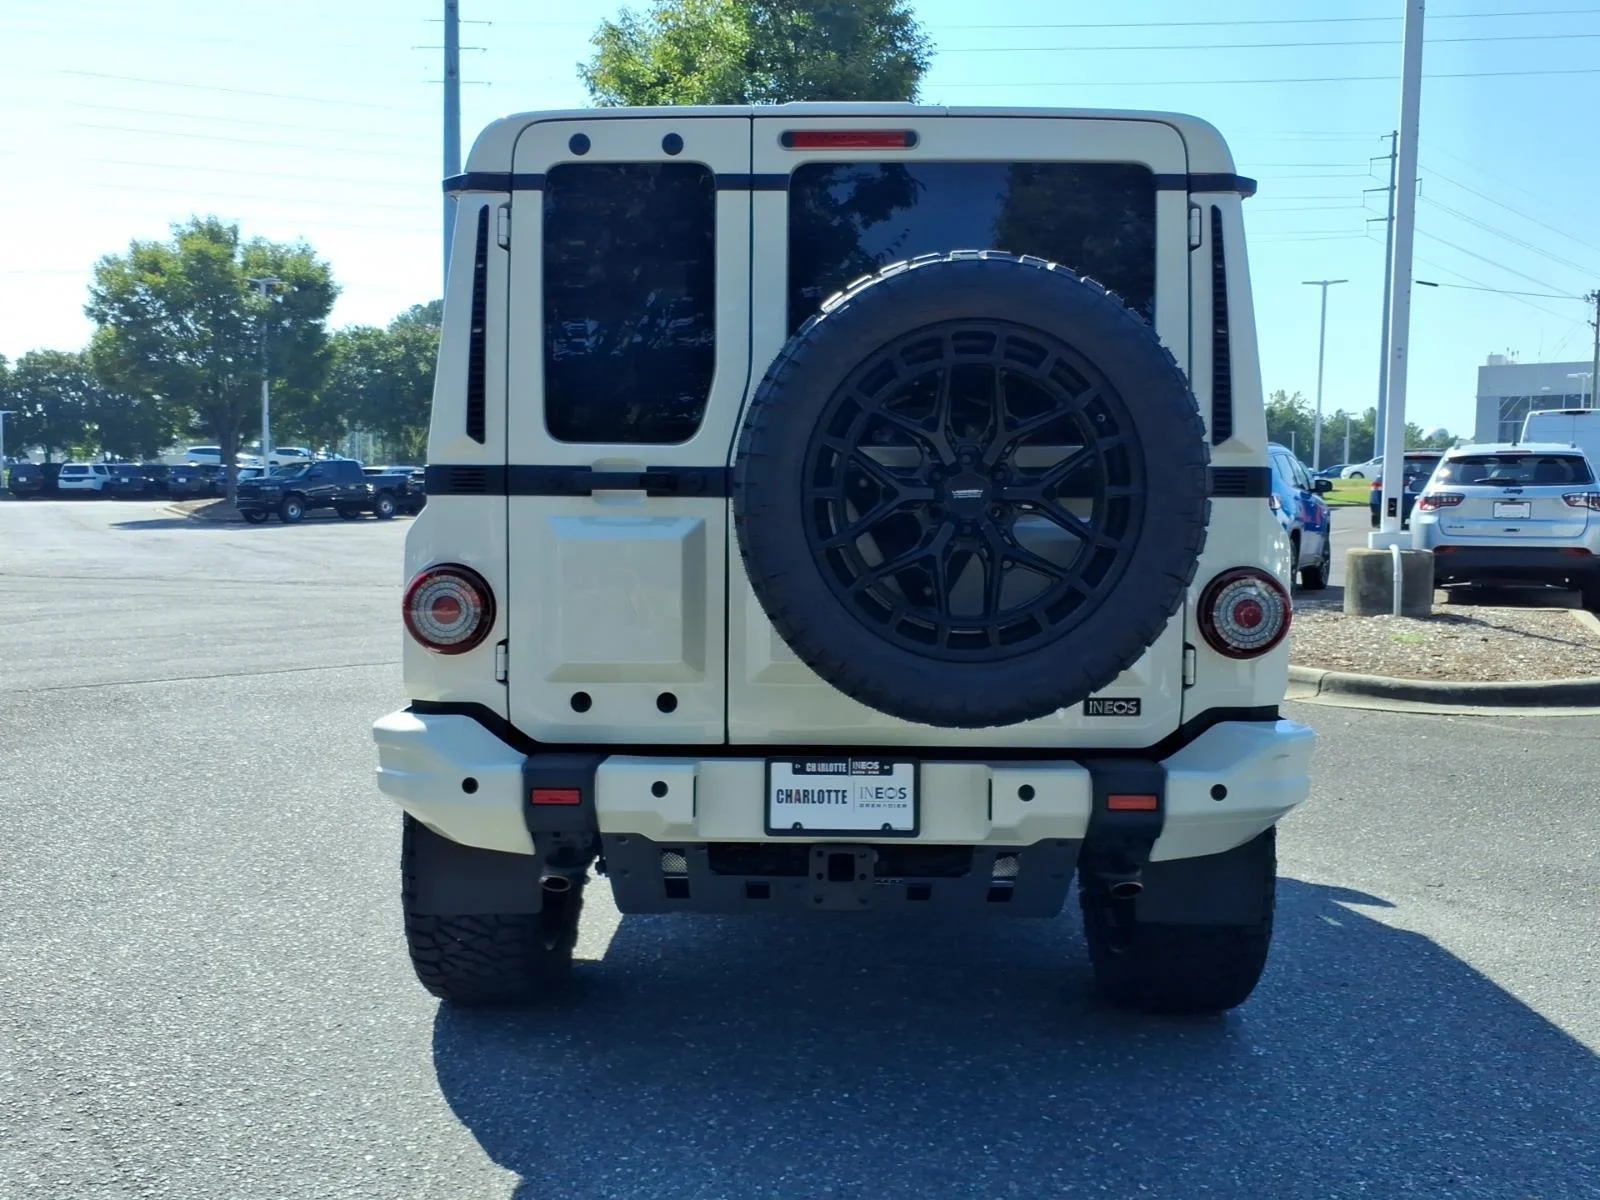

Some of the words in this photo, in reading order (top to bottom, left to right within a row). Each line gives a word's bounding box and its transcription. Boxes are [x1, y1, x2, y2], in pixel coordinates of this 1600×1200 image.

[1088, 700, 1137, 714] INEOS
[852, 761, 880, 770] INEOS
[776, 789, 848, 804] CHARLOTTE
[860, 786, 907, 800] INEOS
